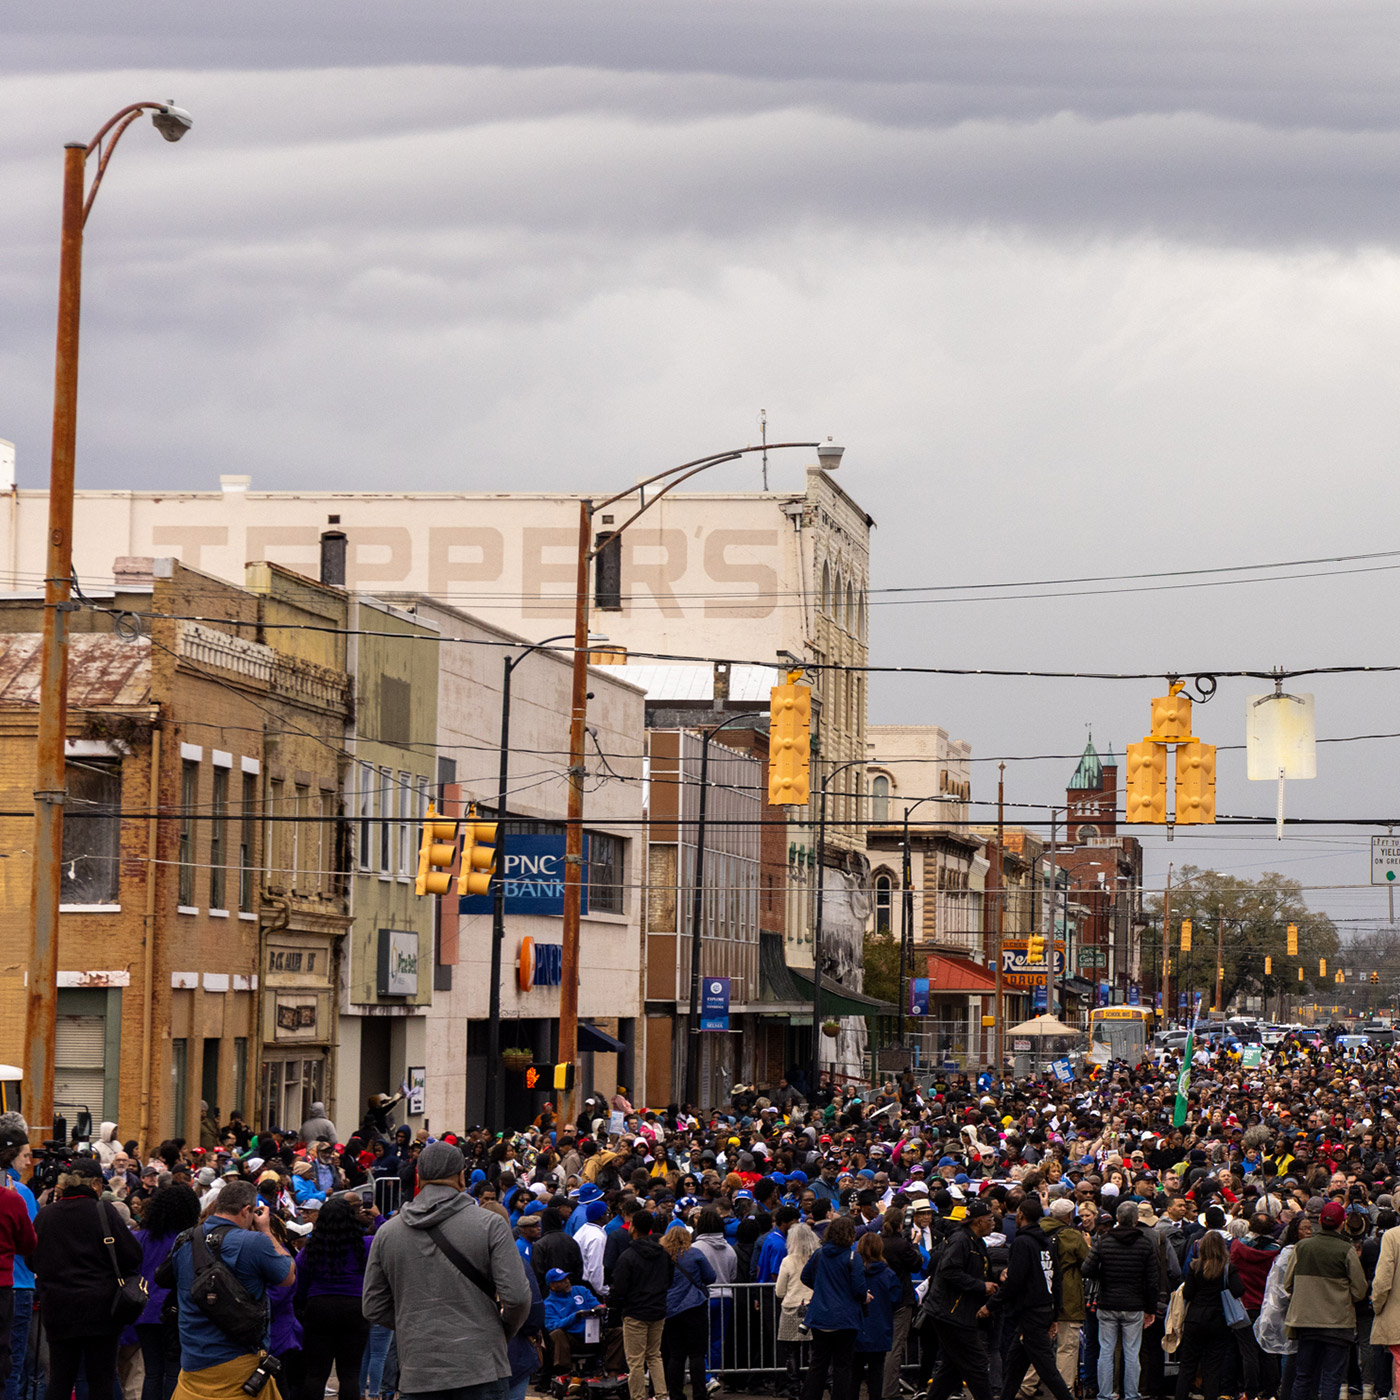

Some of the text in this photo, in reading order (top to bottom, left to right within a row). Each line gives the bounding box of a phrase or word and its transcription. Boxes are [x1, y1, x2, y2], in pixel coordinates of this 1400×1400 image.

[152, 526, 779, 620] TEPPER'S
[1373, 838, 1388, 846] LEFT
[504, 855, 557, 875] PNC
[504, 879, 565, 897] BANK
